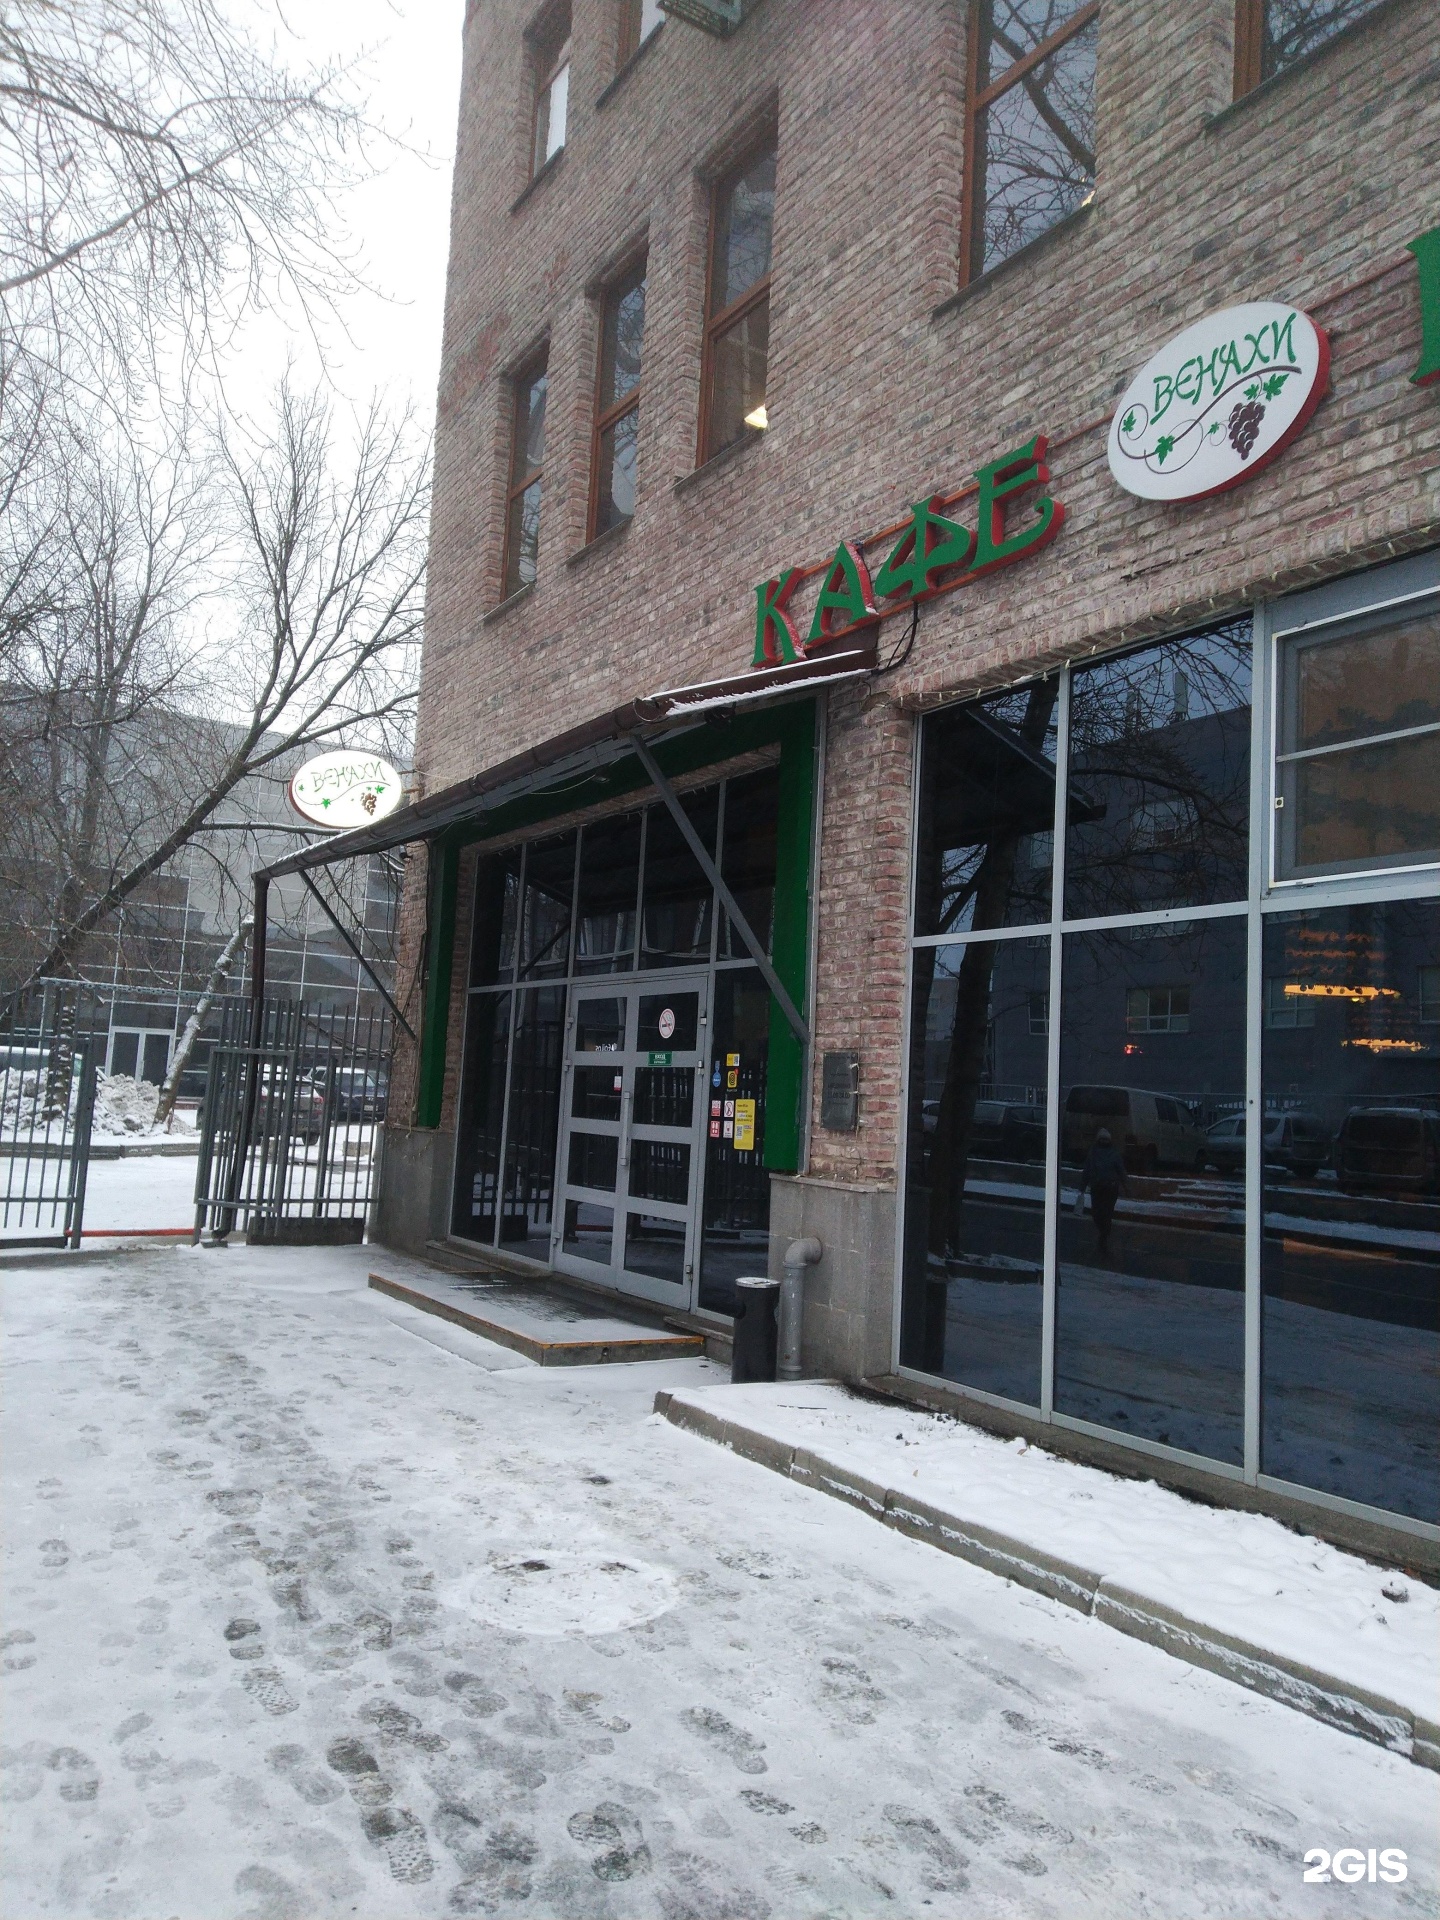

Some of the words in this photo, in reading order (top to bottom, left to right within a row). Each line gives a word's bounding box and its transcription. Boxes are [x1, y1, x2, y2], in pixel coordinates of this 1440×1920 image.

[1150, 312, 1297, 425] ВЕНАХИ
[751, 434, 1064, 669] КАФЕ
[311, 761, 386, 793] ВЕНАХИ
